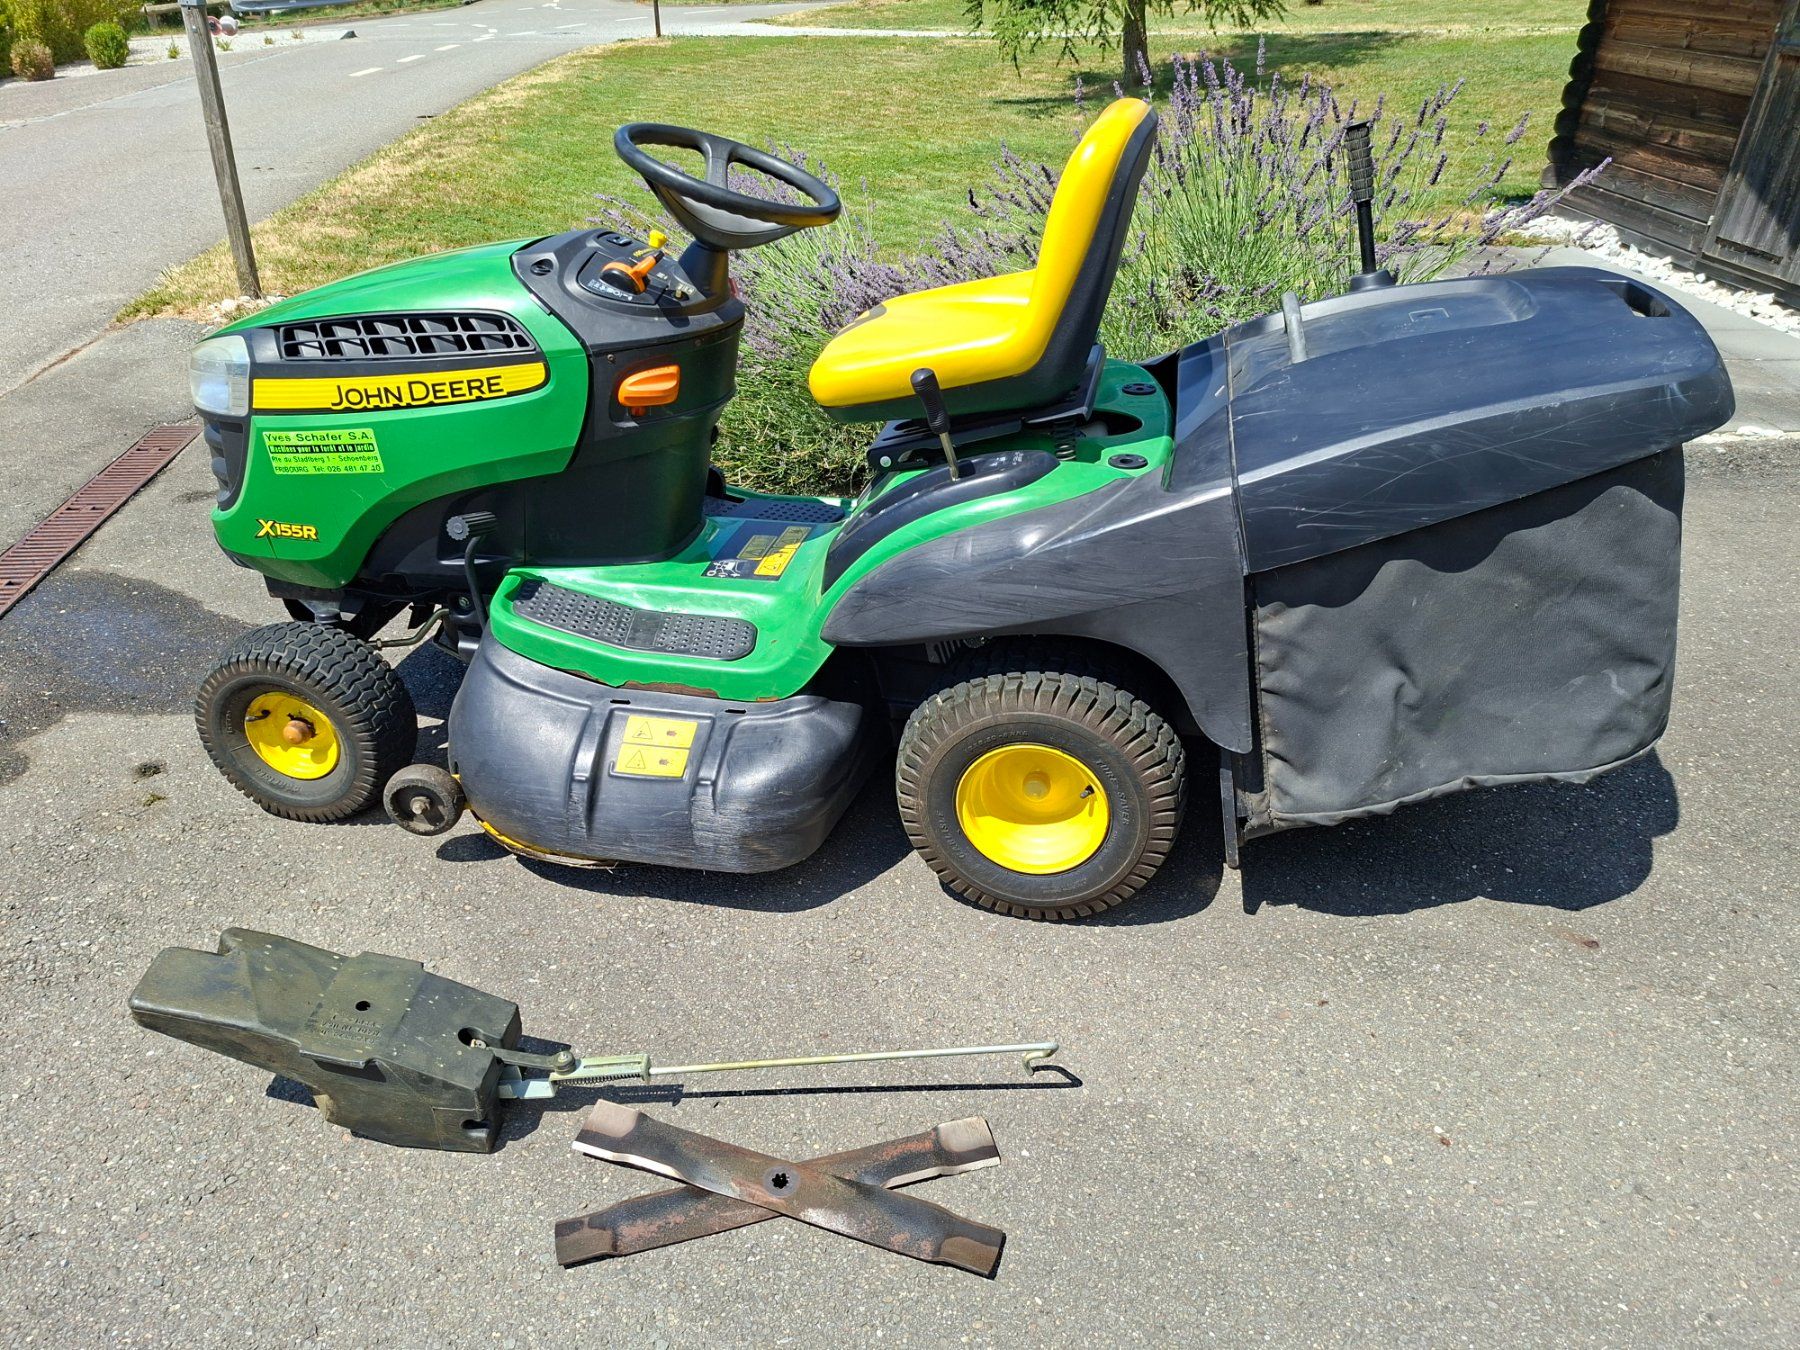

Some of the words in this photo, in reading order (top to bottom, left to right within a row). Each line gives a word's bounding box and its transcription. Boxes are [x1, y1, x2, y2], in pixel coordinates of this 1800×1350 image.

[331, 384, 403, 407] JOHN
[407, 375, 504, 402] DEERE
[264, 433, 291, 442] Yves
[348, 431, 373, 440] S.A.
[338, 455, 378, 463] Schoenberg
[255, 519, 318, 541] X155R
